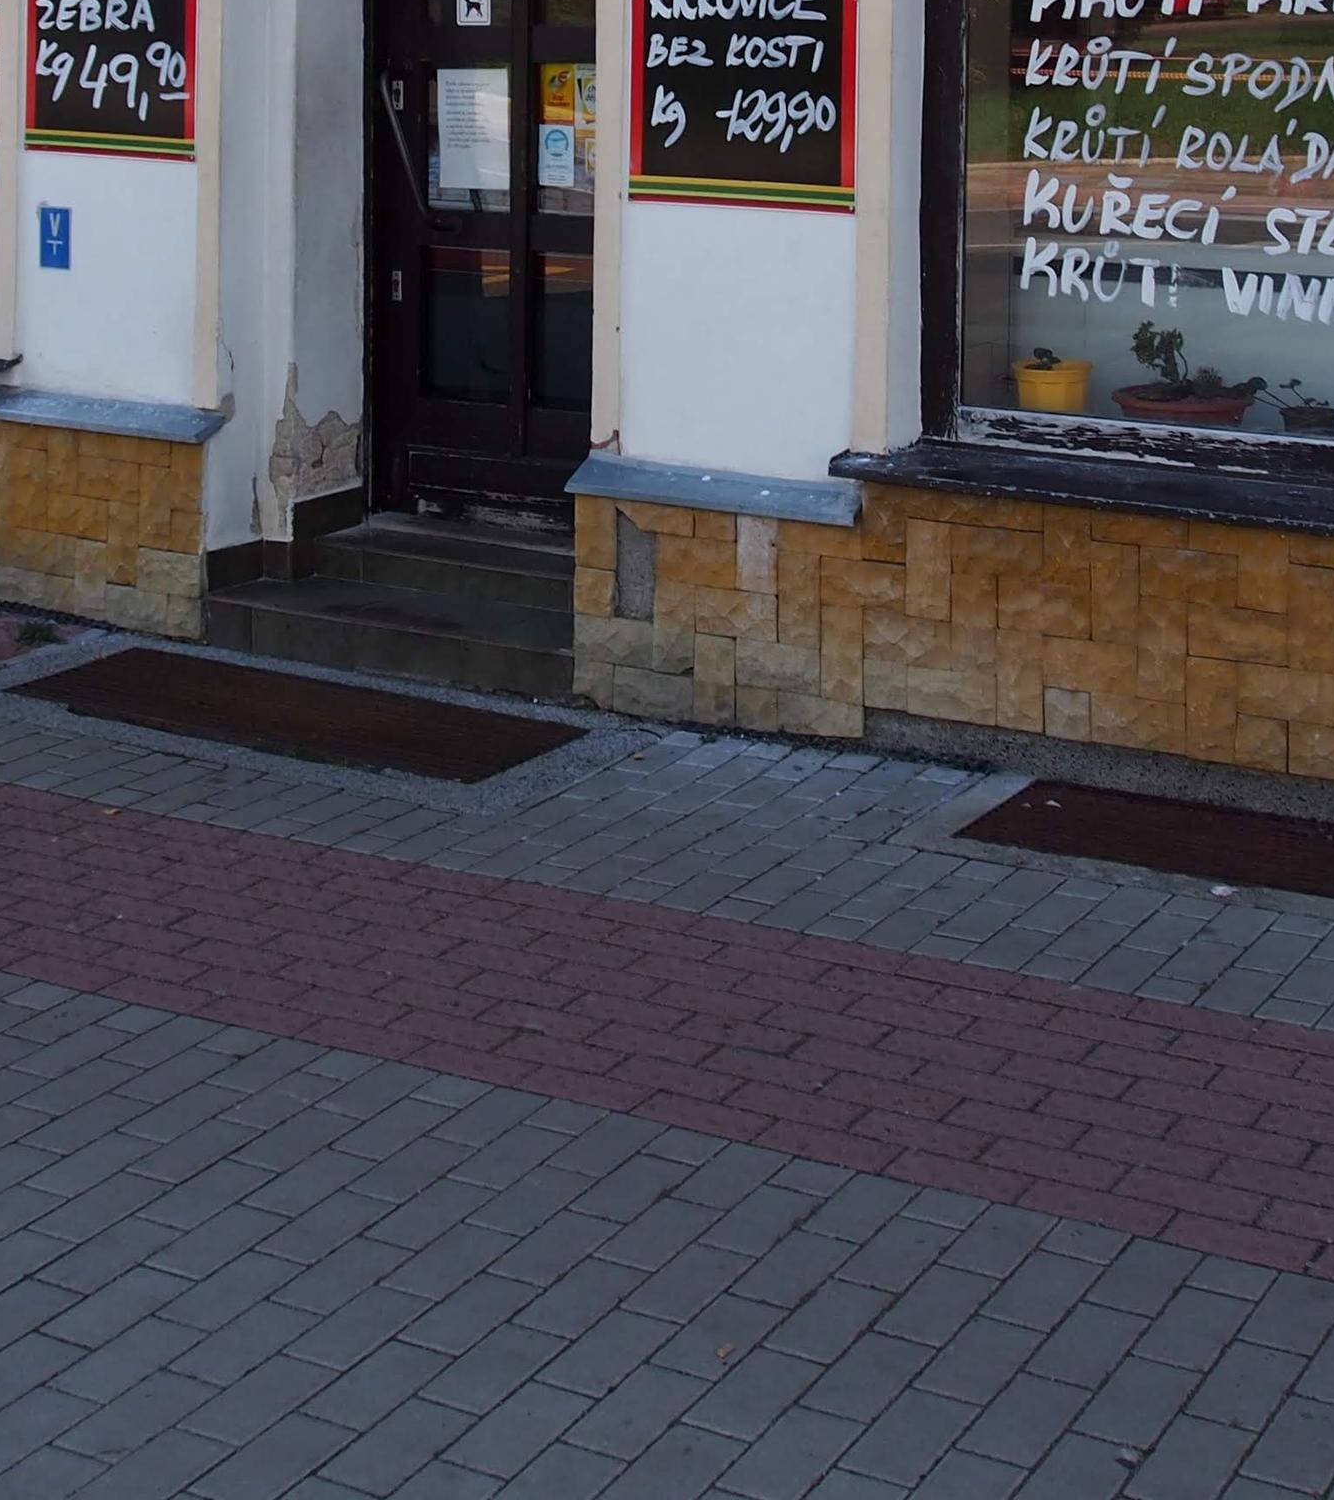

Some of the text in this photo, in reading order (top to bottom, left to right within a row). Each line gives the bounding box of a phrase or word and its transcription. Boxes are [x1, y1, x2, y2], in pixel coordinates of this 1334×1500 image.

[647, 33, 824, 73] BEZ KOSTI
[1025, 36, 1177, 95] KRŮTÍ
[1023, 104, 1167, 169] KRŮTÍ
[1023, 168, 1238, 246] KUŘECÍ
